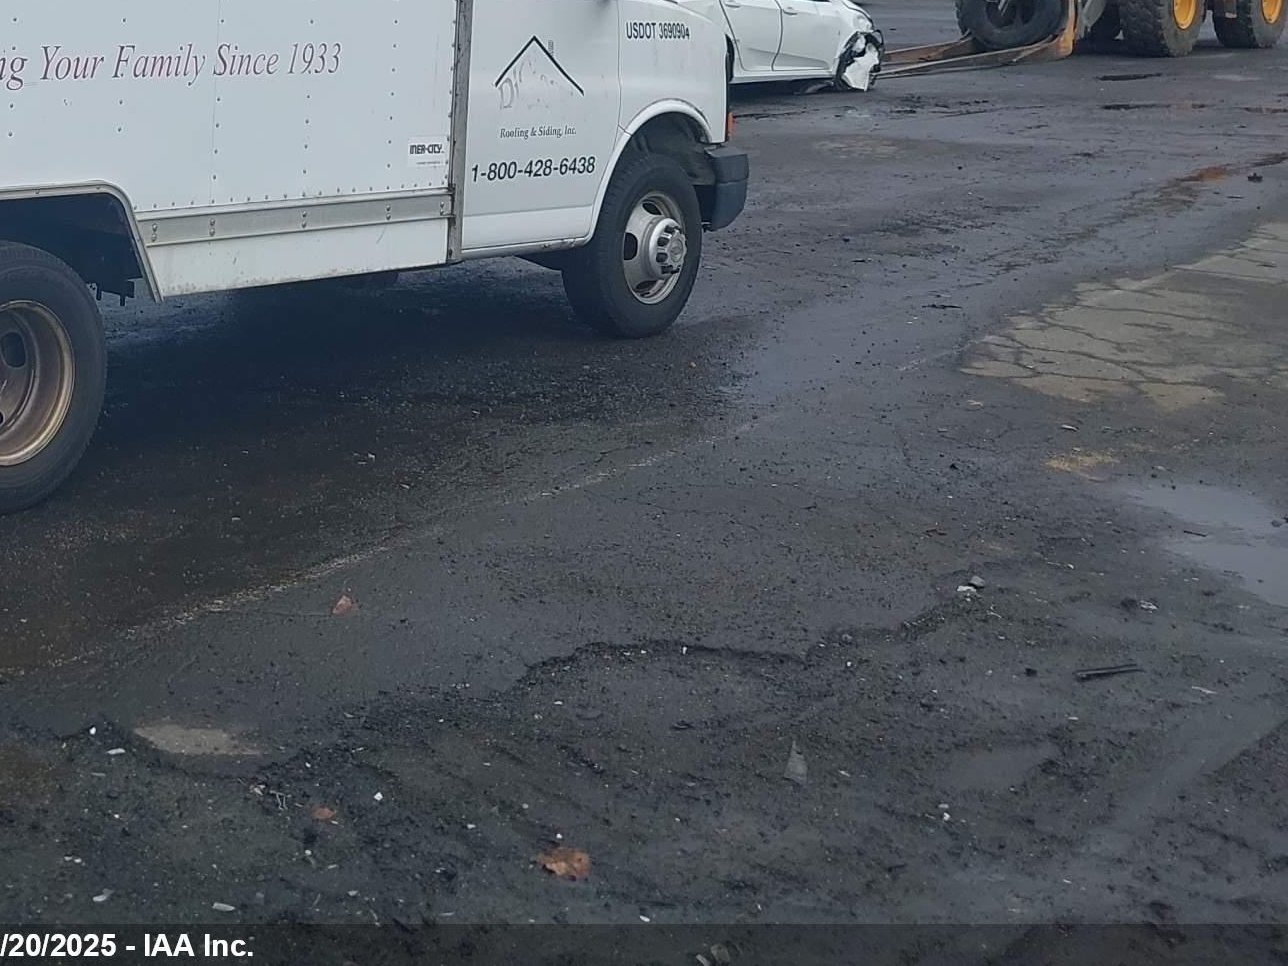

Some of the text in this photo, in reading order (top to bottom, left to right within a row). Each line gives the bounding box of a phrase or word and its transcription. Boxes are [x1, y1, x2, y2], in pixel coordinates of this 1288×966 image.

[625, 21, 656, 39] USDOT
[40, 44, 104, 82] Your
[111, 43, 206, 87] Family
[212, 42, 279, 76] Since
[286, 42, 343, 76] 1933
[500, 127, 529, 140] Roofing
[530, 126, 537, 137] &
[471, 155, 596, 183] 1-800-428-6438
